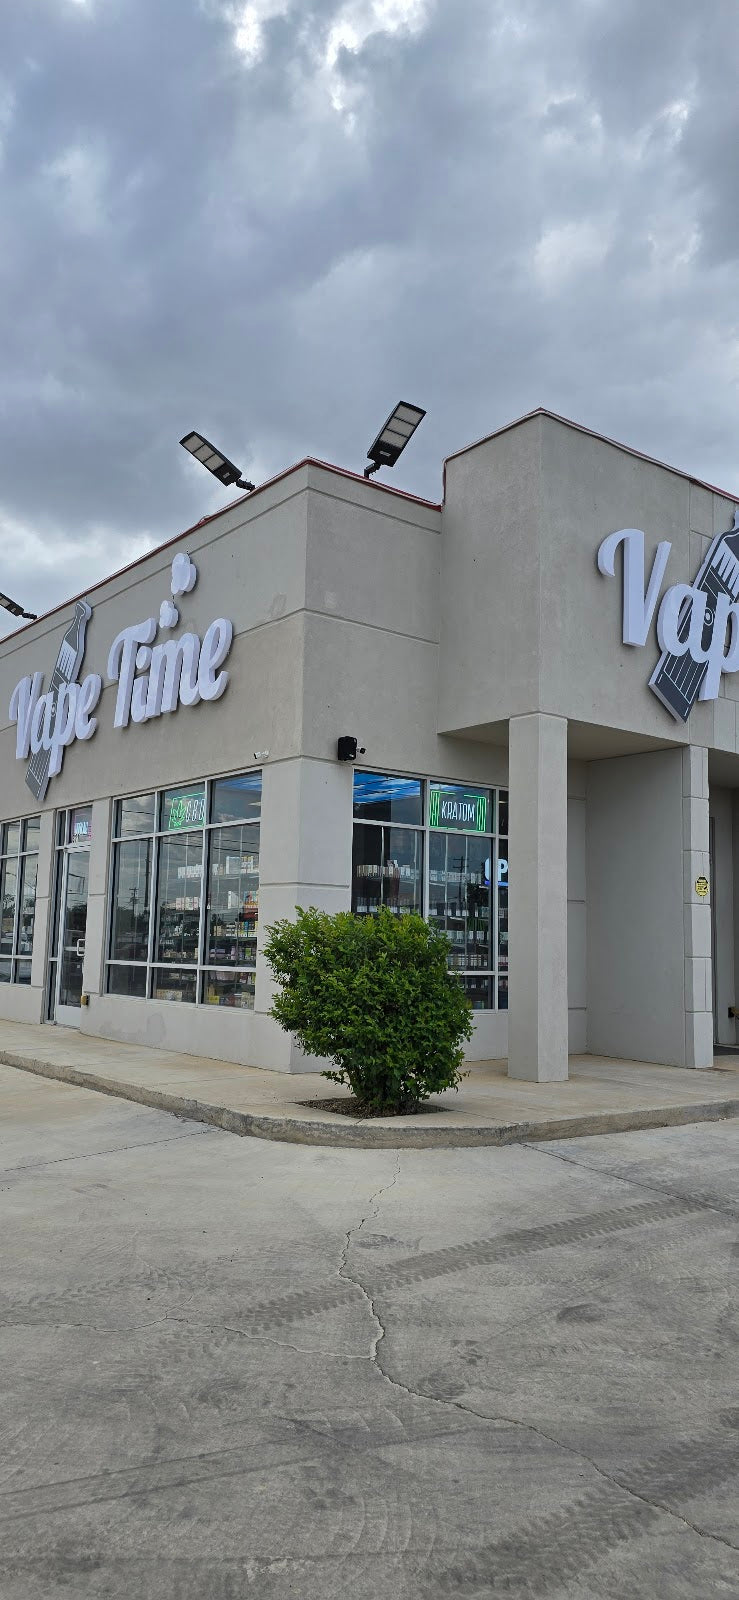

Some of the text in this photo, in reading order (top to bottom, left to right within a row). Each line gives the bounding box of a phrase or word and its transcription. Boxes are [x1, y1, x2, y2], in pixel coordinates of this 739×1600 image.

[10, 617, 233, 777] Vape Time
[441, 800, 475, 822] KRATOM
